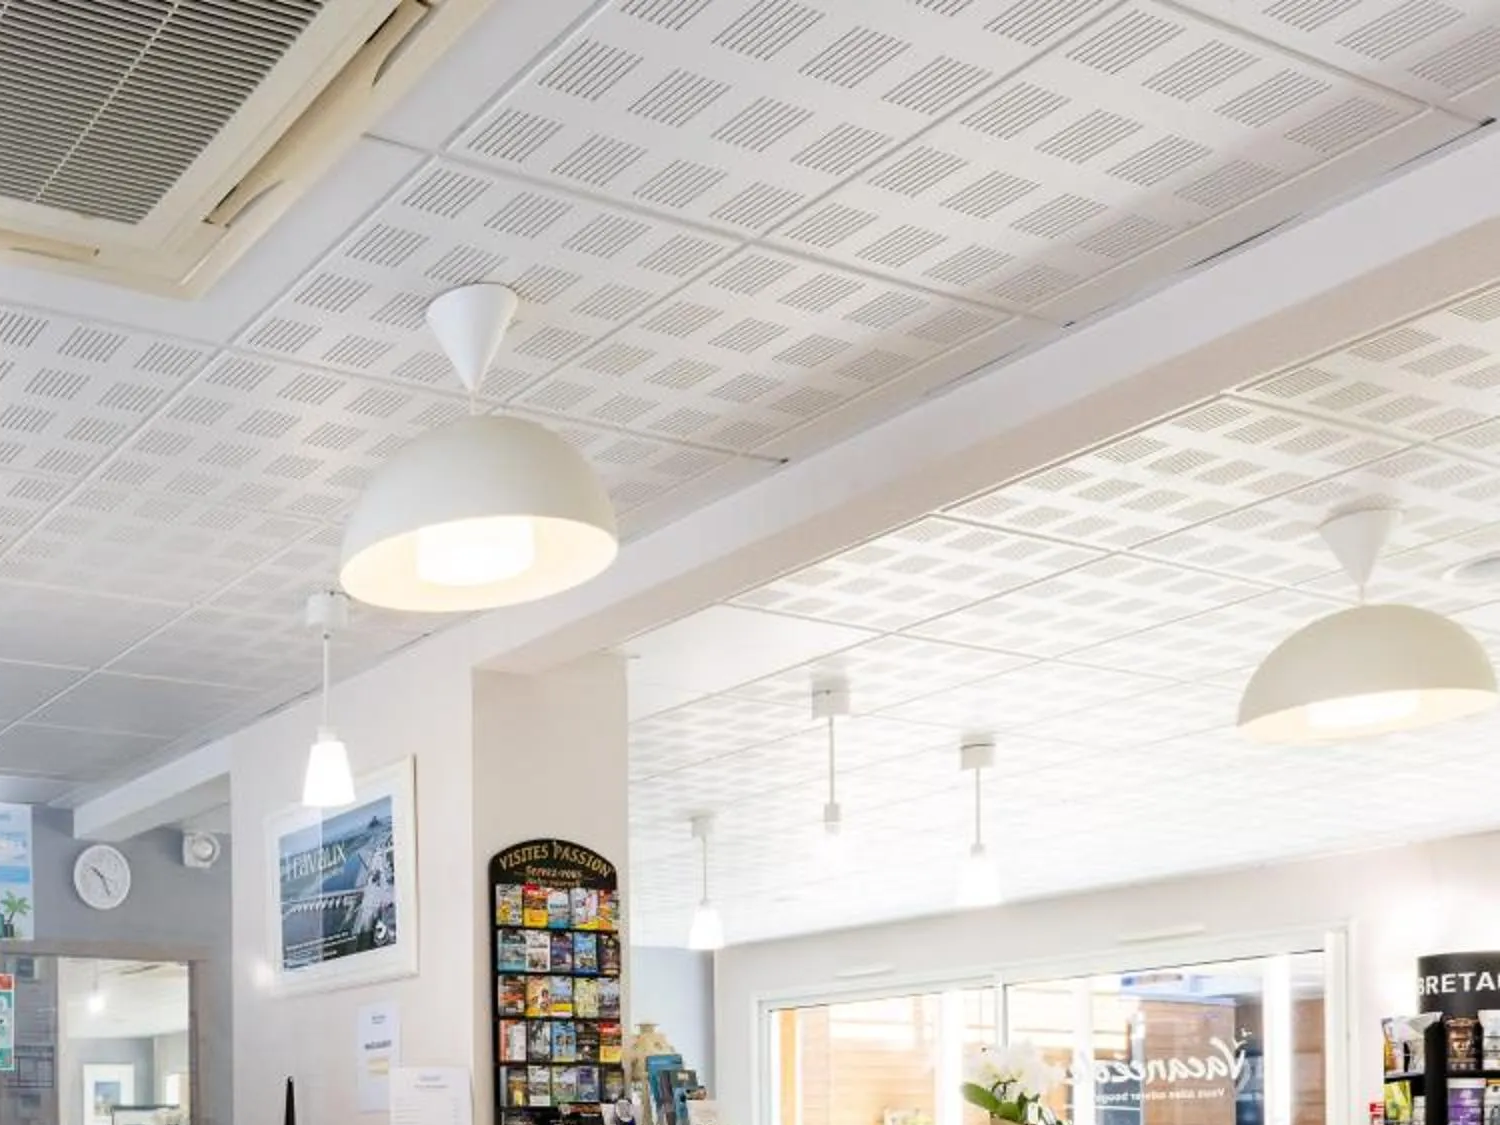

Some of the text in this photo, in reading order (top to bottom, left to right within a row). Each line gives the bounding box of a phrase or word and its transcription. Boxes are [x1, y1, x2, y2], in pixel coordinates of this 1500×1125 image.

[499, 842, 612, 878] VISITES PASSION
[1418, 971, 1500, 996] BRETA
